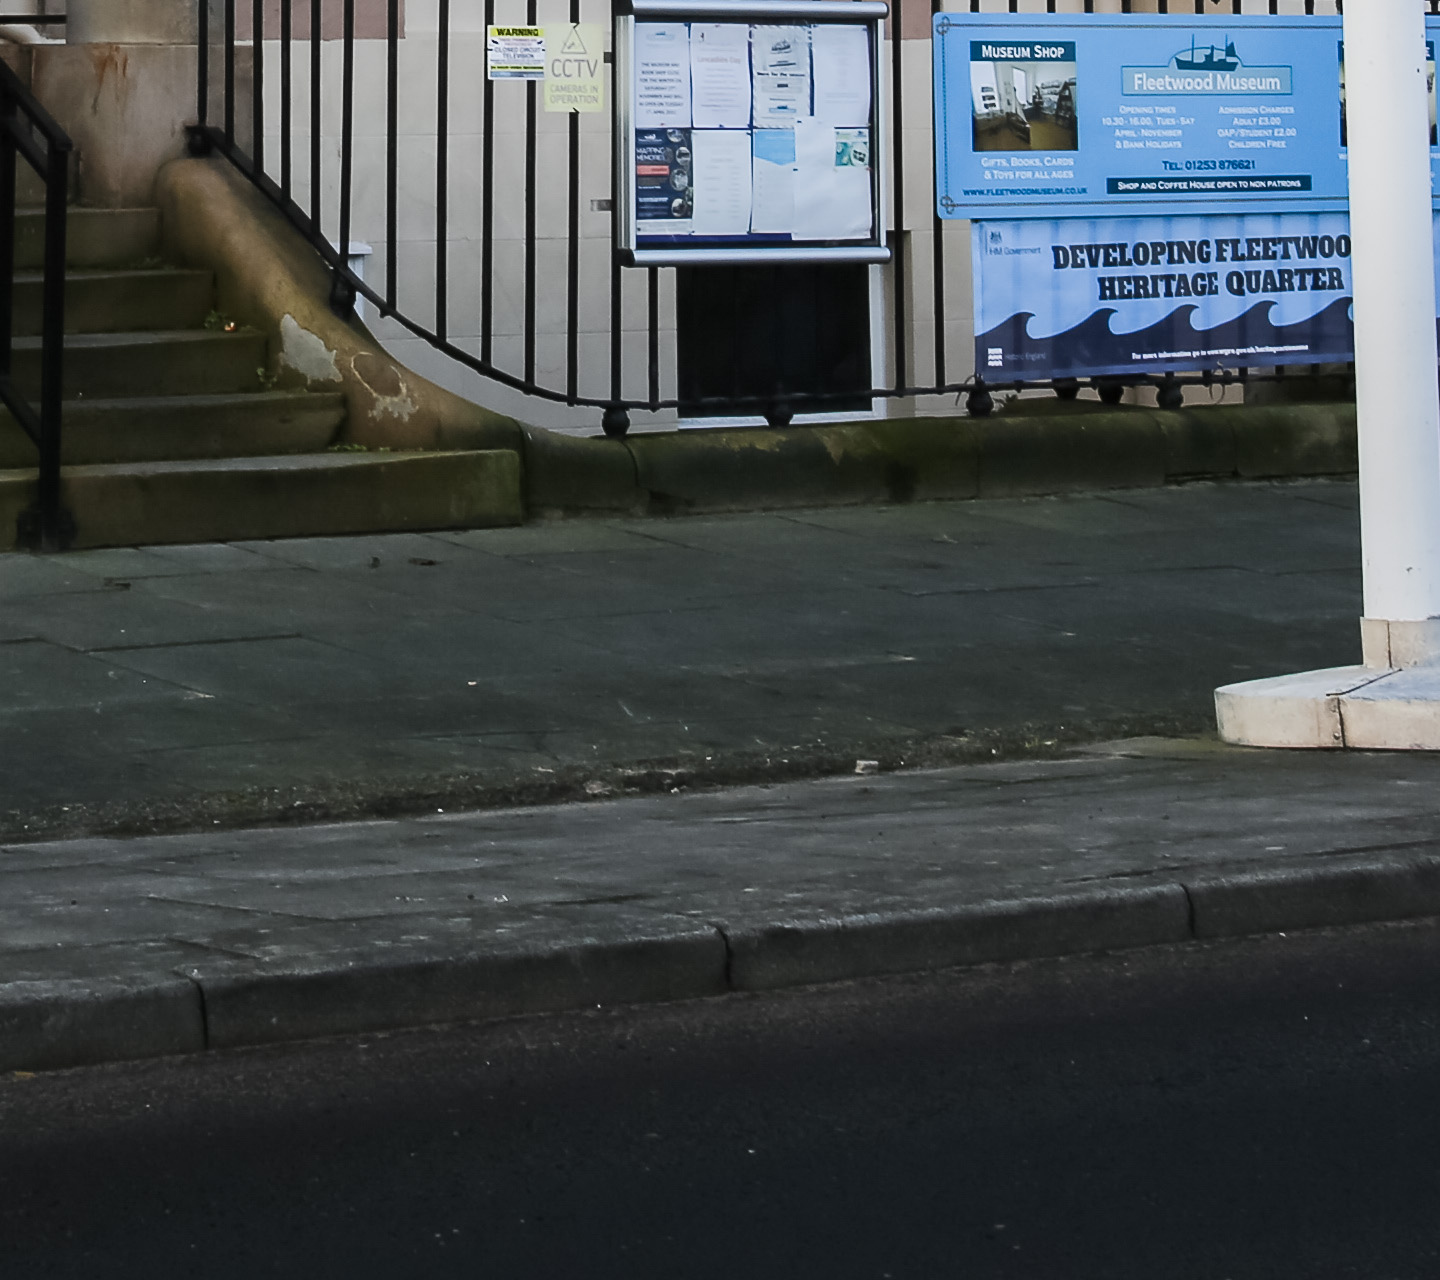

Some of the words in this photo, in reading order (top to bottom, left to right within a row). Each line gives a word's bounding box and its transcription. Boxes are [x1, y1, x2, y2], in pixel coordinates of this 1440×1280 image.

[496, 28, 539, 37] WARNING
[982, 45, 1031, 58] MUSEUM
[1034, 44, 1065, 58] SHOP
[551, 58, 598, 78] CCTV
[1133, 72, 1213, 91] Fleetwood
[1216, 73, 1280, 91] Museum
[550, 84, 588, 93] CAMERAS
[590, 84, 599, 93] IN
[550, 94, 599, 104] OPERATION
[1119, 105, 1154, 114] OPENING
[1233, 117, 1257, 125] ADULT
[1044, 156, 1074, 167] CARDS
[1185, 160, 1216, 171] 01253
[1218, 159, 1256, 170] 876621
[992, 170, 1014, 179] TOYS
[1015, 170, 1034, 179] FOR
[1034, 170, 1050, 179] ALL
[1051, 170, 1074, 179] AGES
[1117, 182, 1140, 190] SHOP
[1140, 182, 1157, 190] AND
[1158, 180, 1188, 189] COFFEE
[1189, 180, 1216, 189] HOUSE
[1238, 180, 1249, 188] TO
[1249, 180, 1267, 188] NON
[1267, 179, 1301, 188] PATRONS
[1052, 240, 1212, 270] DEVELOPING
[1214, 234, 1351, 263] FLEETWOO
[1098, 271, 1219, 300] HERITAGE
[1225, 267, 1345, 297] QUARTER
